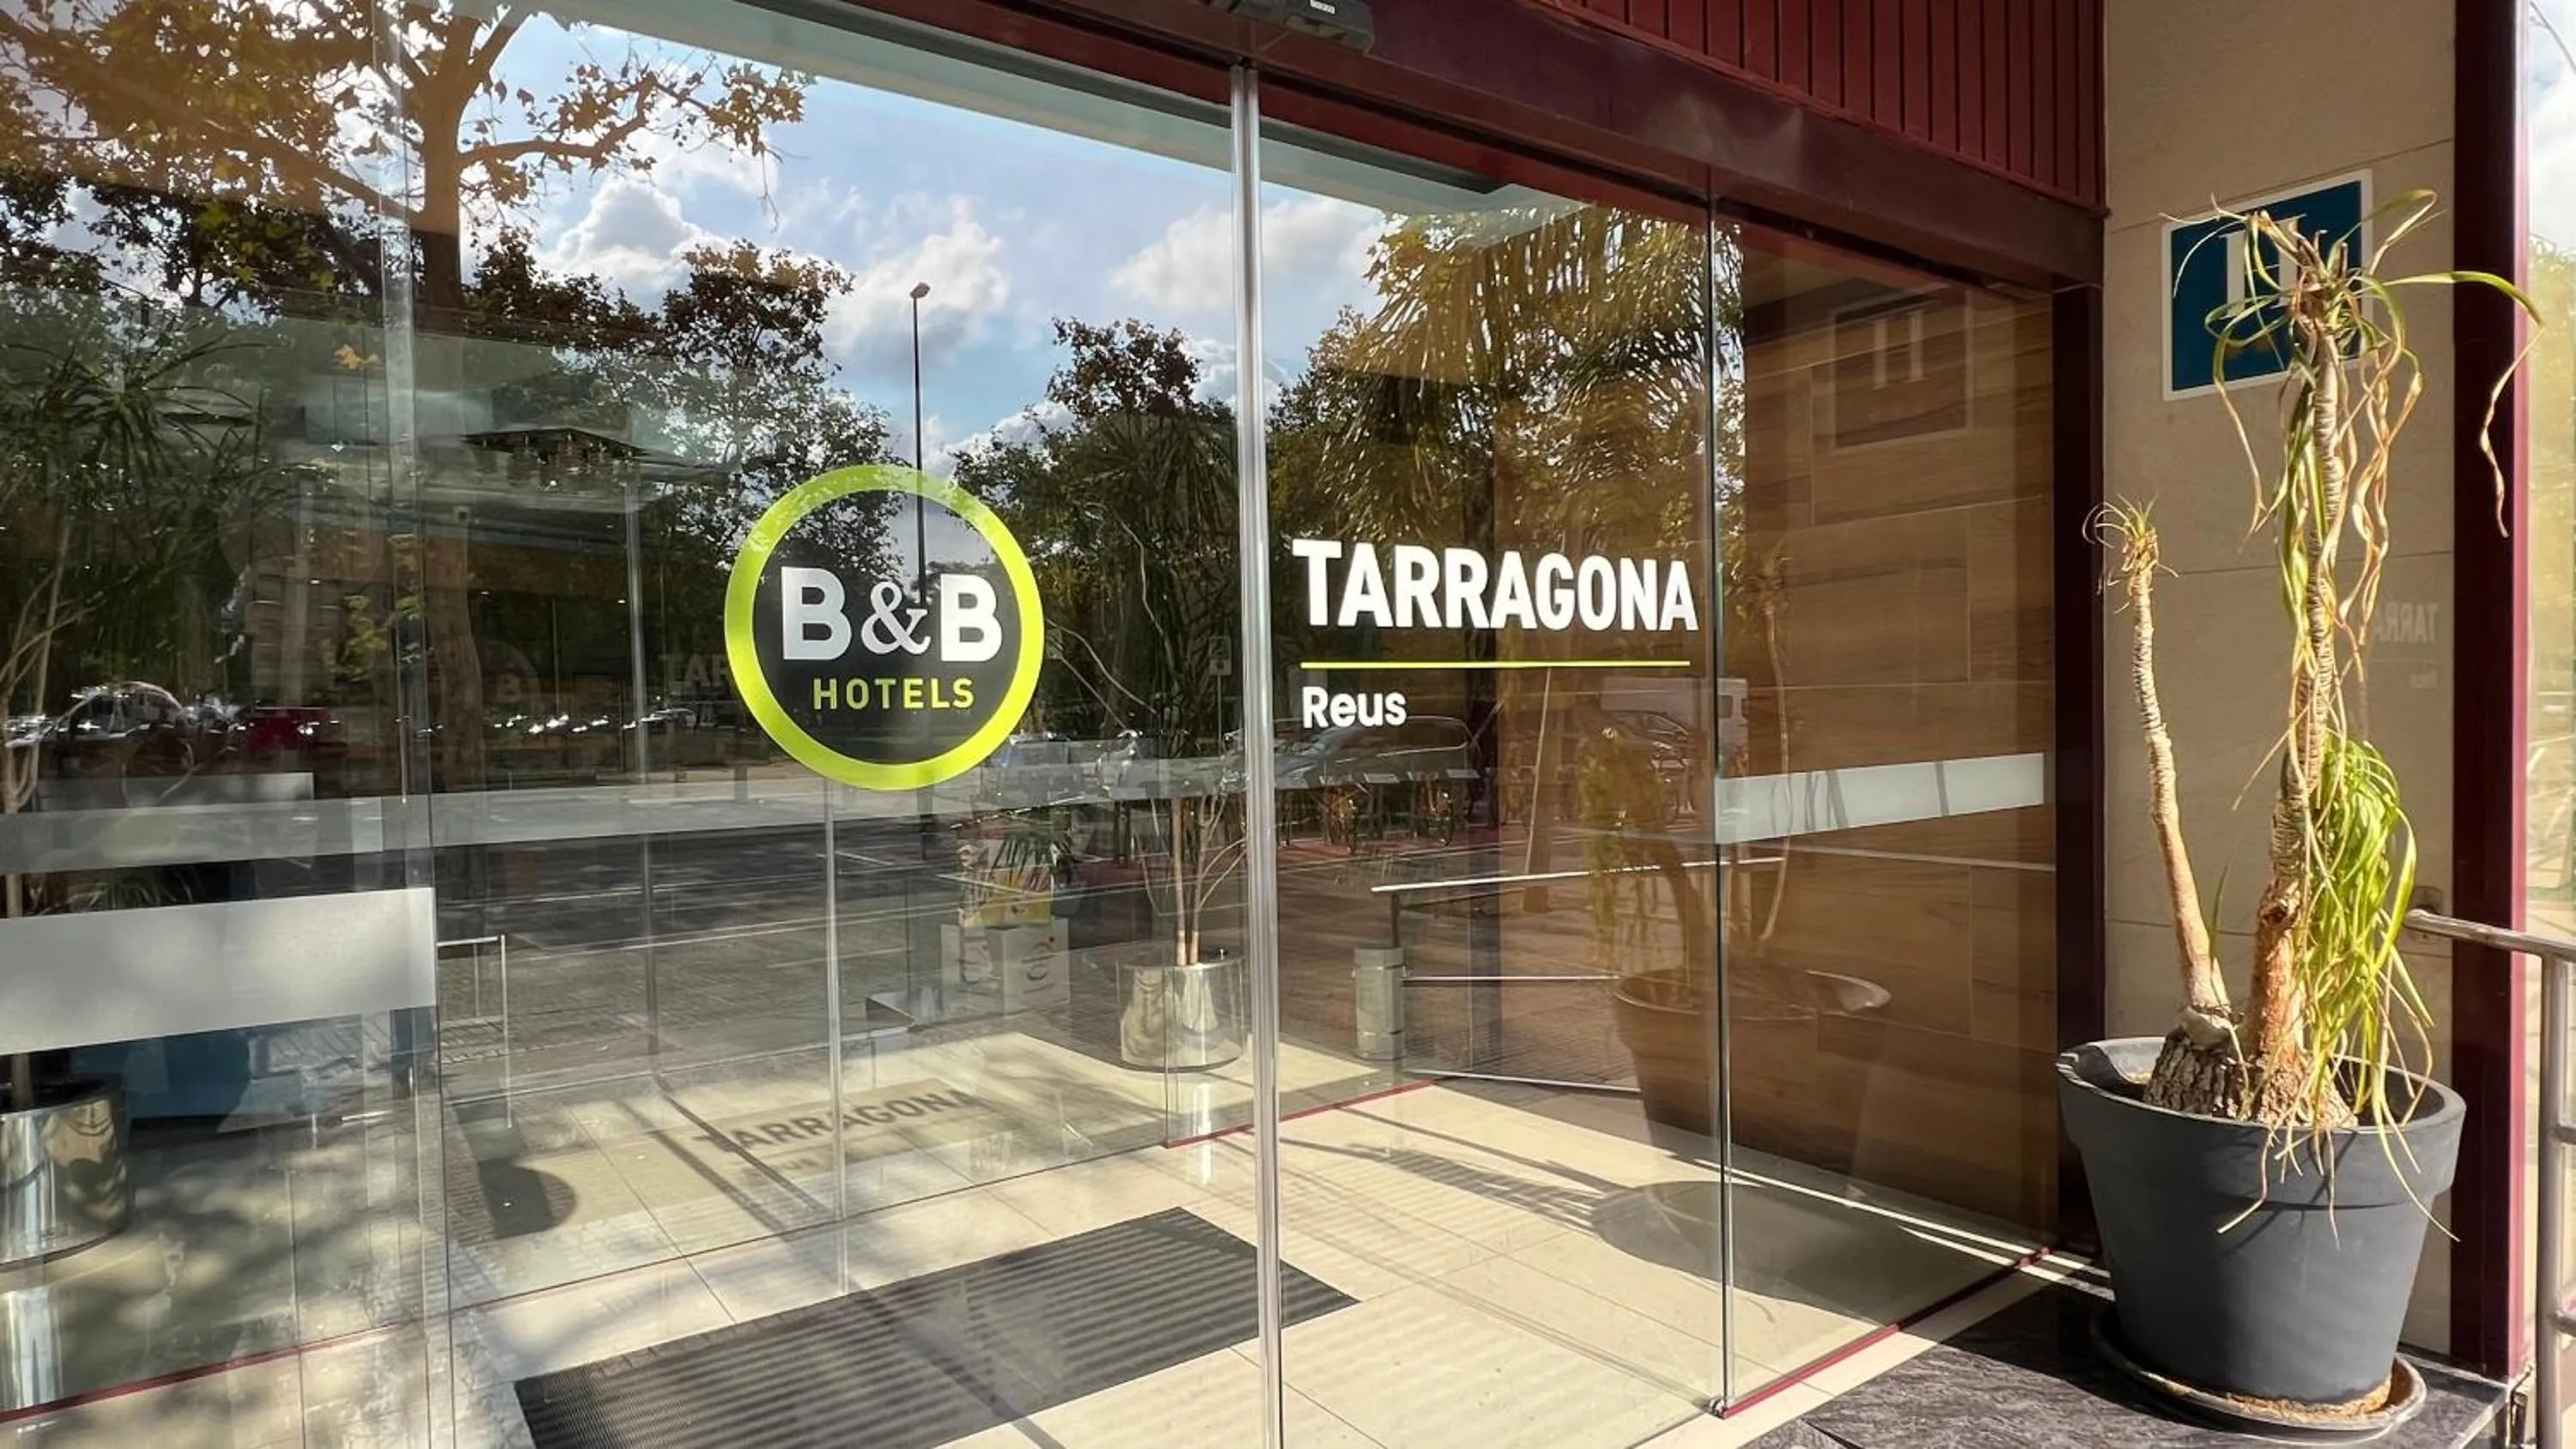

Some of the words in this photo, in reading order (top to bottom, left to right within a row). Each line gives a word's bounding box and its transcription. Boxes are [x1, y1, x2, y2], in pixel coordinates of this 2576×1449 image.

[781, 566, 1003, 662] B&B
[1291, 538, 1699, 632] TARRAGONA
[812, 677, 975, 711] HOTELS
[1302, 686, 1407, 729] Reus
